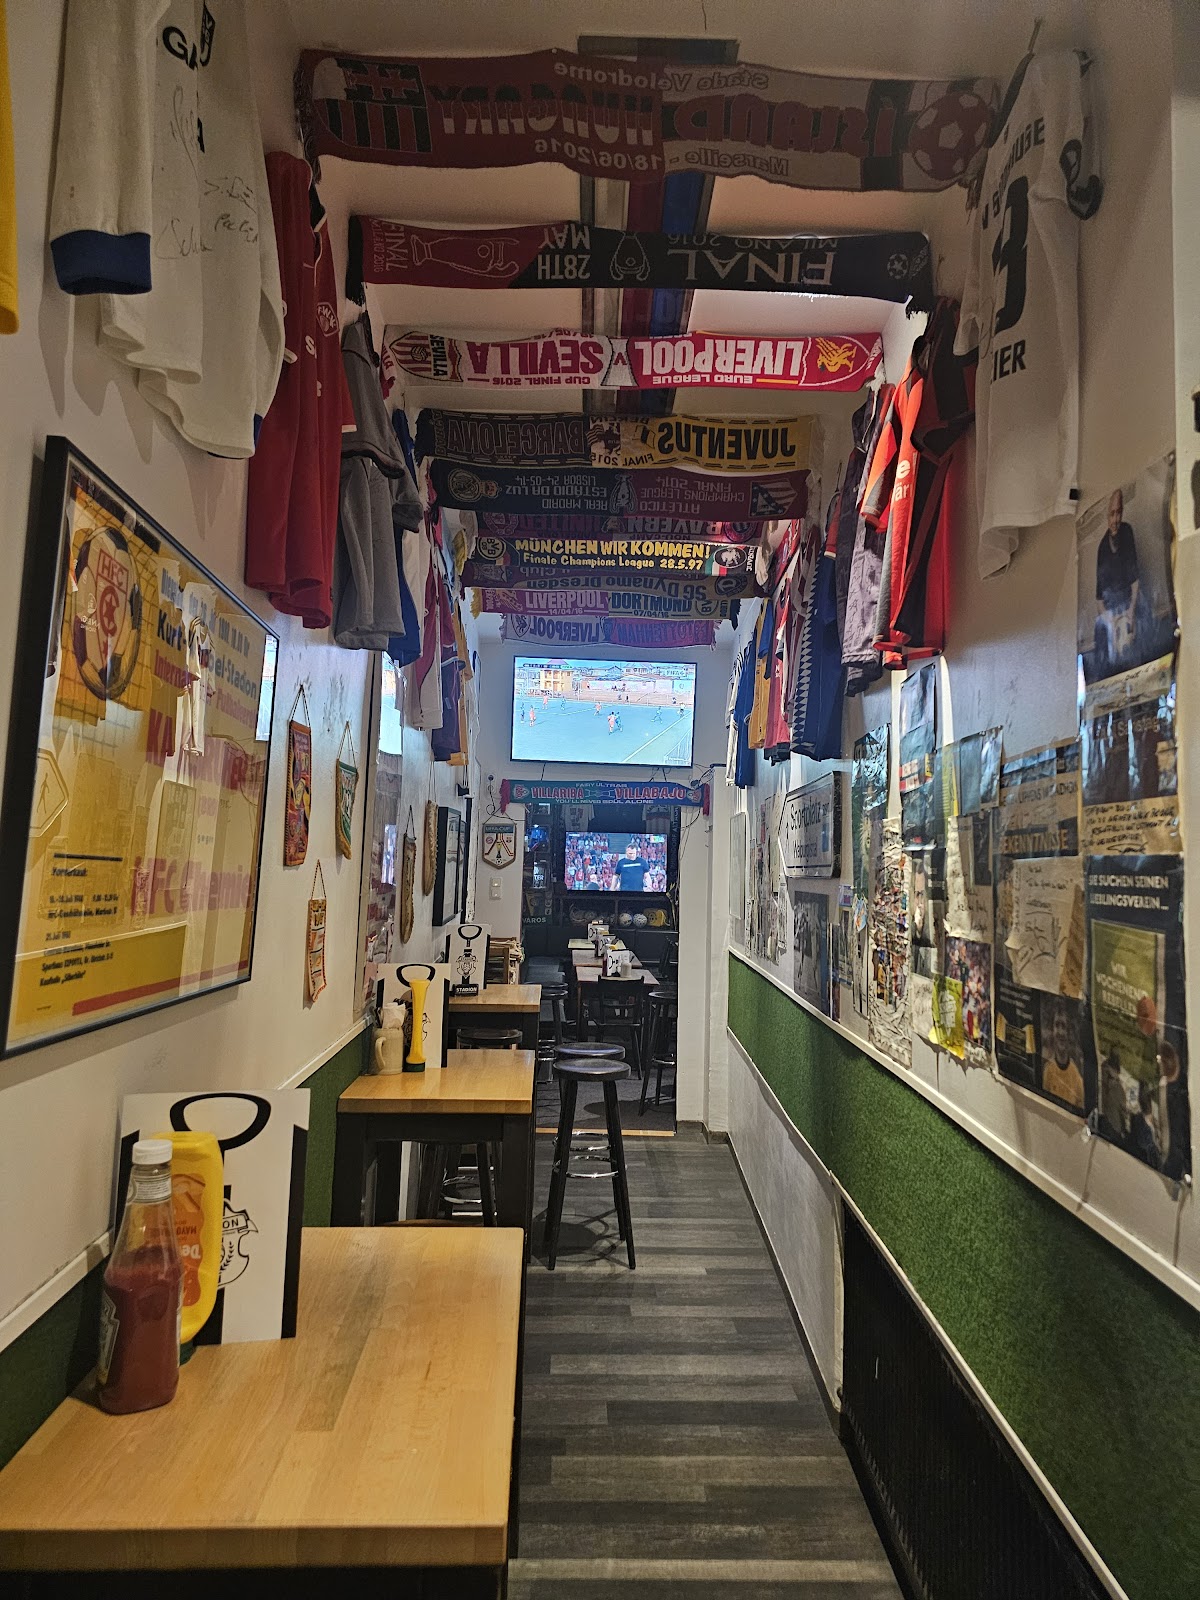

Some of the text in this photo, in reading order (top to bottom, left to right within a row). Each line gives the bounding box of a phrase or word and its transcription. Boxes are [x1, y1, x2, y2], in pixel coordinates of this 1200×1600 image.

[538, 223, 590, 250] MAY
[537, 254, 590, 280] 28TH
[667, 248, 836, 287] FINAL
[430, 334, 448, 377] SEVILLA
[466, 339, 604, 376] SEVILLA
[634, 339, 804, 377] LIVERPOOL
[492, 376, 591, 386] CUP FINAL 2016
[652, 374, 753, 384] EURO LEAGUE
[563, 474, 597, 486] LISBOA
[656, 476, 731, 493] FINAL 2014
[505, 484, 529, 496] LUZ
[532, 485, 550, 496] DA
[640, 487, 745, 503] CHAMPIONS LEAGUE
[541, 498, 608, 511] REAL MADRID
[626, 515, 722, 535] BAYERN
[514, 537, 711, 560] MÜNCHEN WIR KOMMEN!
[523, 552, 704, 571] Finale Champions League 28.5.97
[526, 577, 707, 601] SG Dynamo Dresden
[525, 591, 605, 609] LIVERPOOL
[611, 592, 692, 612] DORTMUND
[531, 787, 585, 799] VILLARIBA
[613, 786, 687, 800] VILLABAJO
[1099, 874, 1135, 887] SUCHEN
[456, 986, 477, 994] STADION
